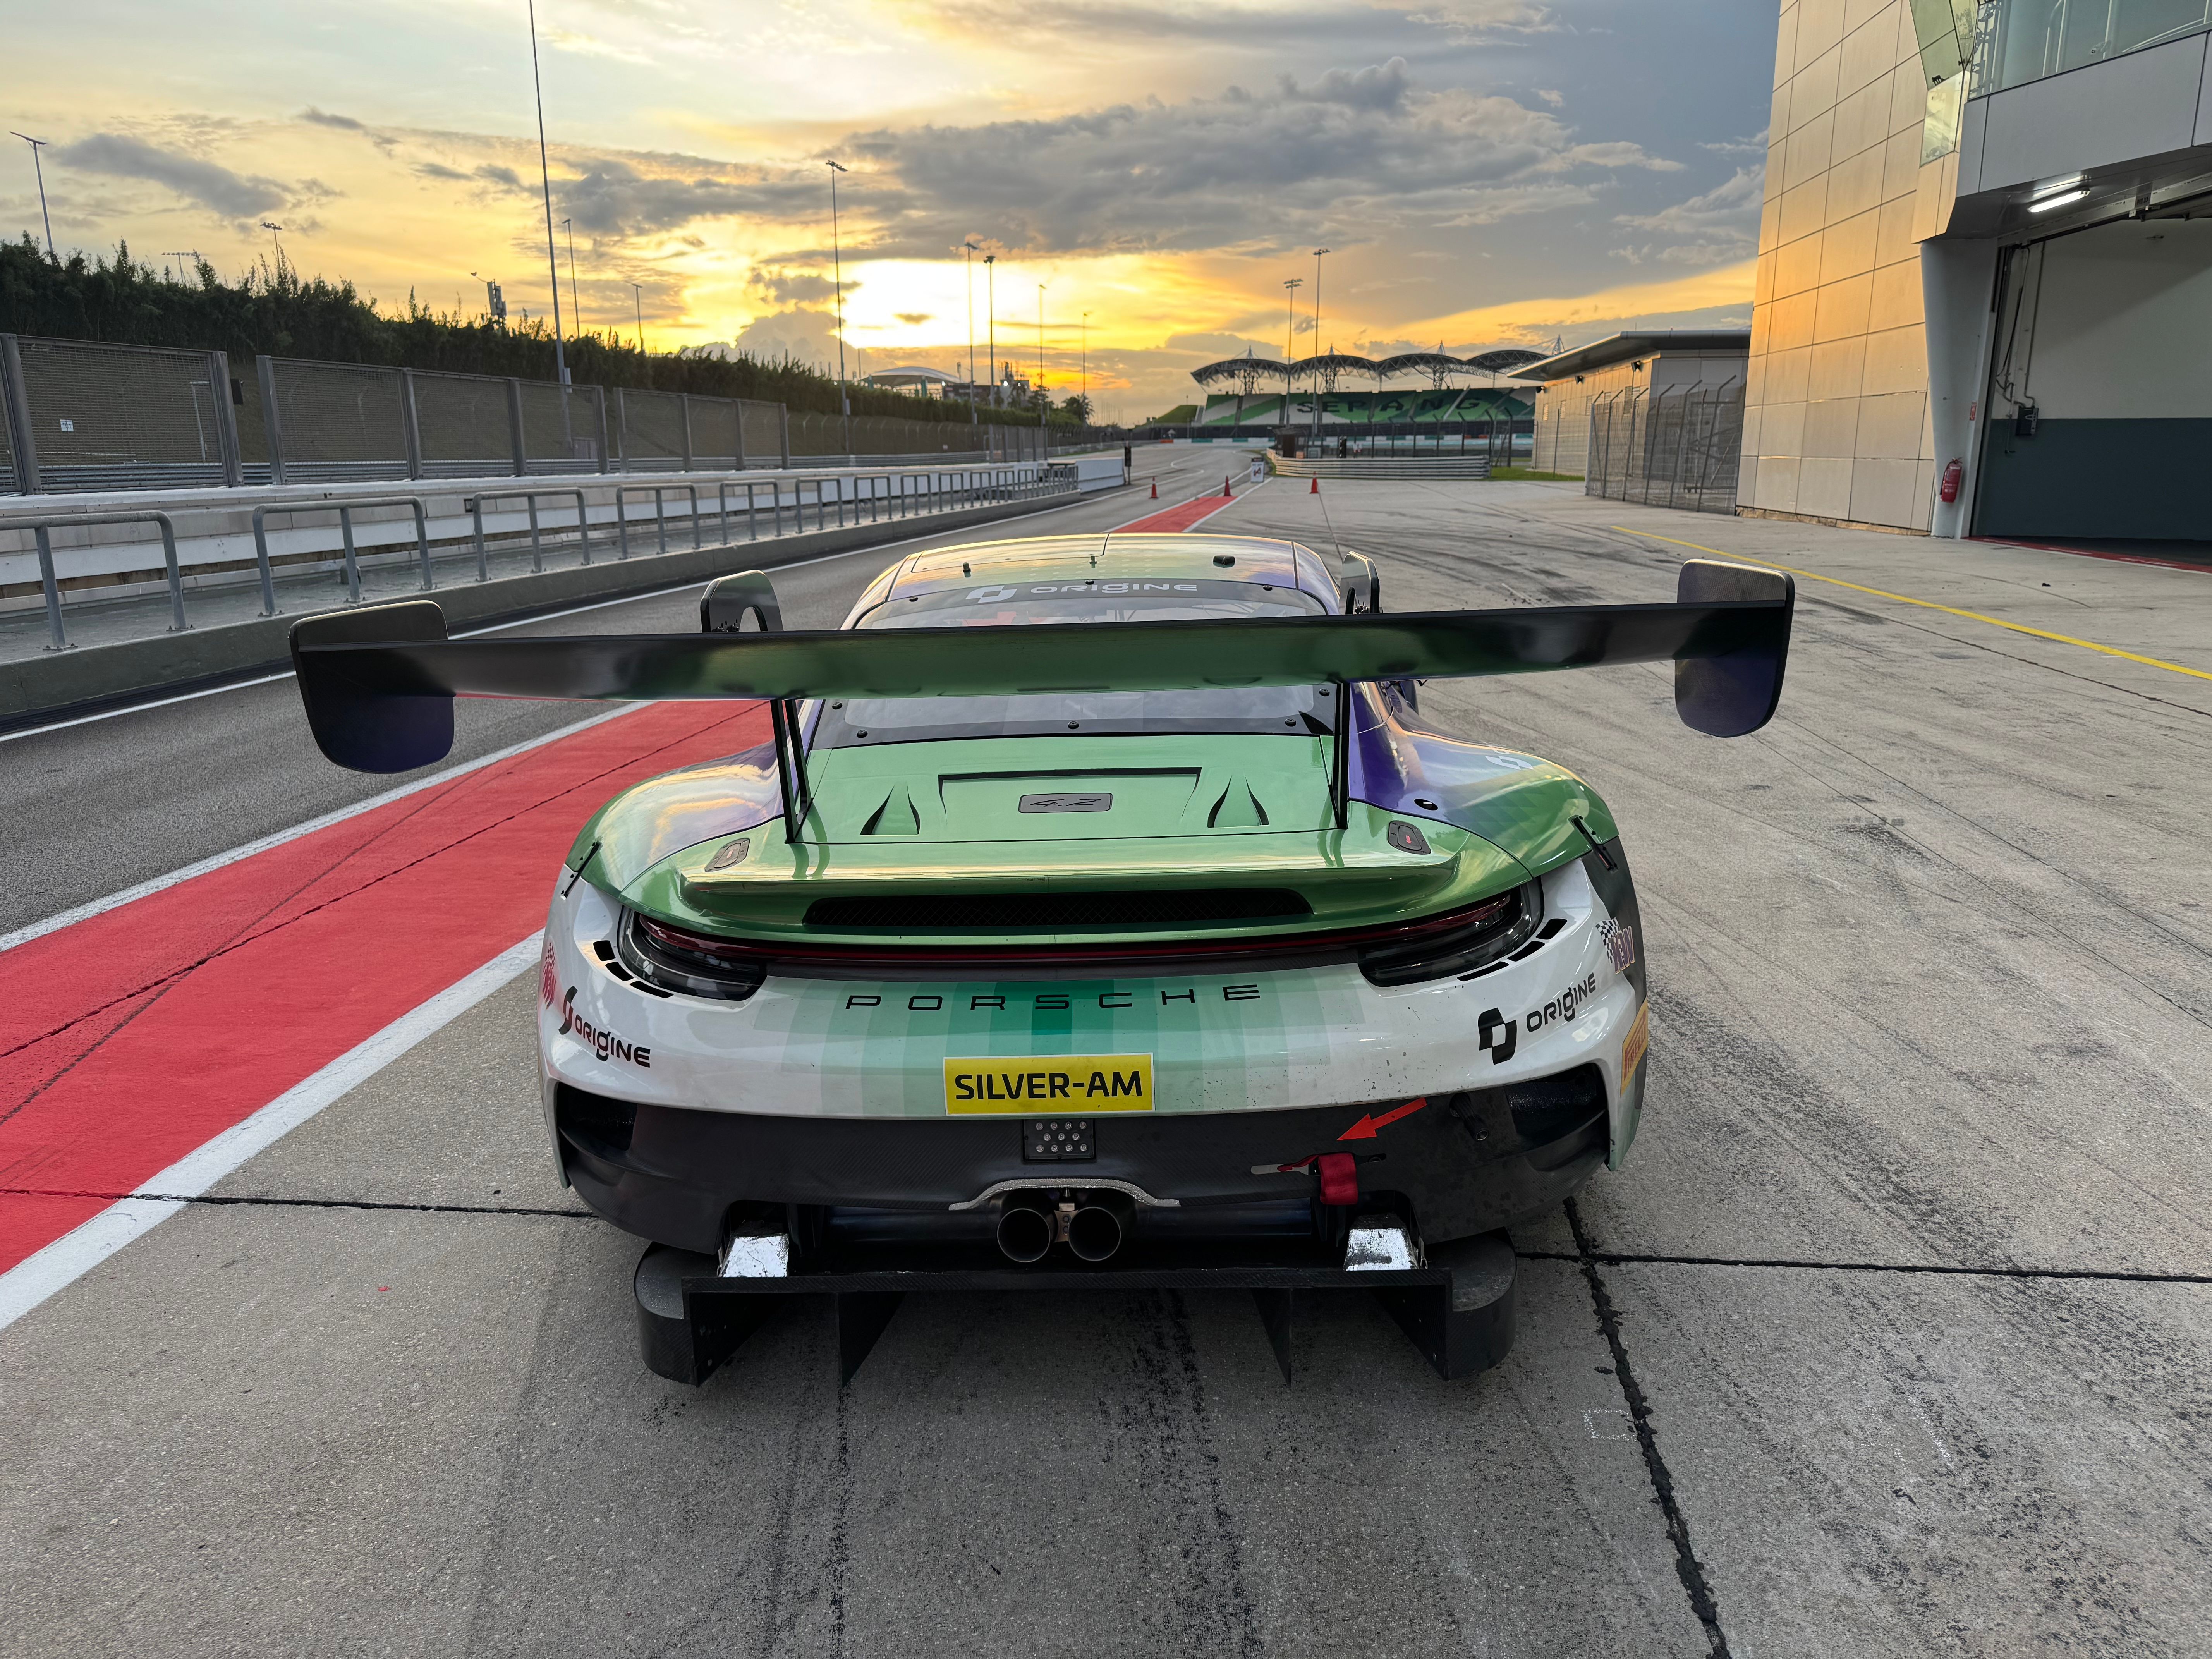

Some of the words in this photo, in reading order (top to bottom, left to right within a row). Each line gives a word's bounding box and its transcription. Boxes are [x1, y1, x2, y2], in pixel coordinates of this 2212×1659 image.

[1297, 398, 1481, 413] SEPANG
[1029, 799, 1101, 807] 4.2
[846, 984, 1261, 1011] PORSCHE
[955, 1071, 1142, 1100] SILVER-AM
